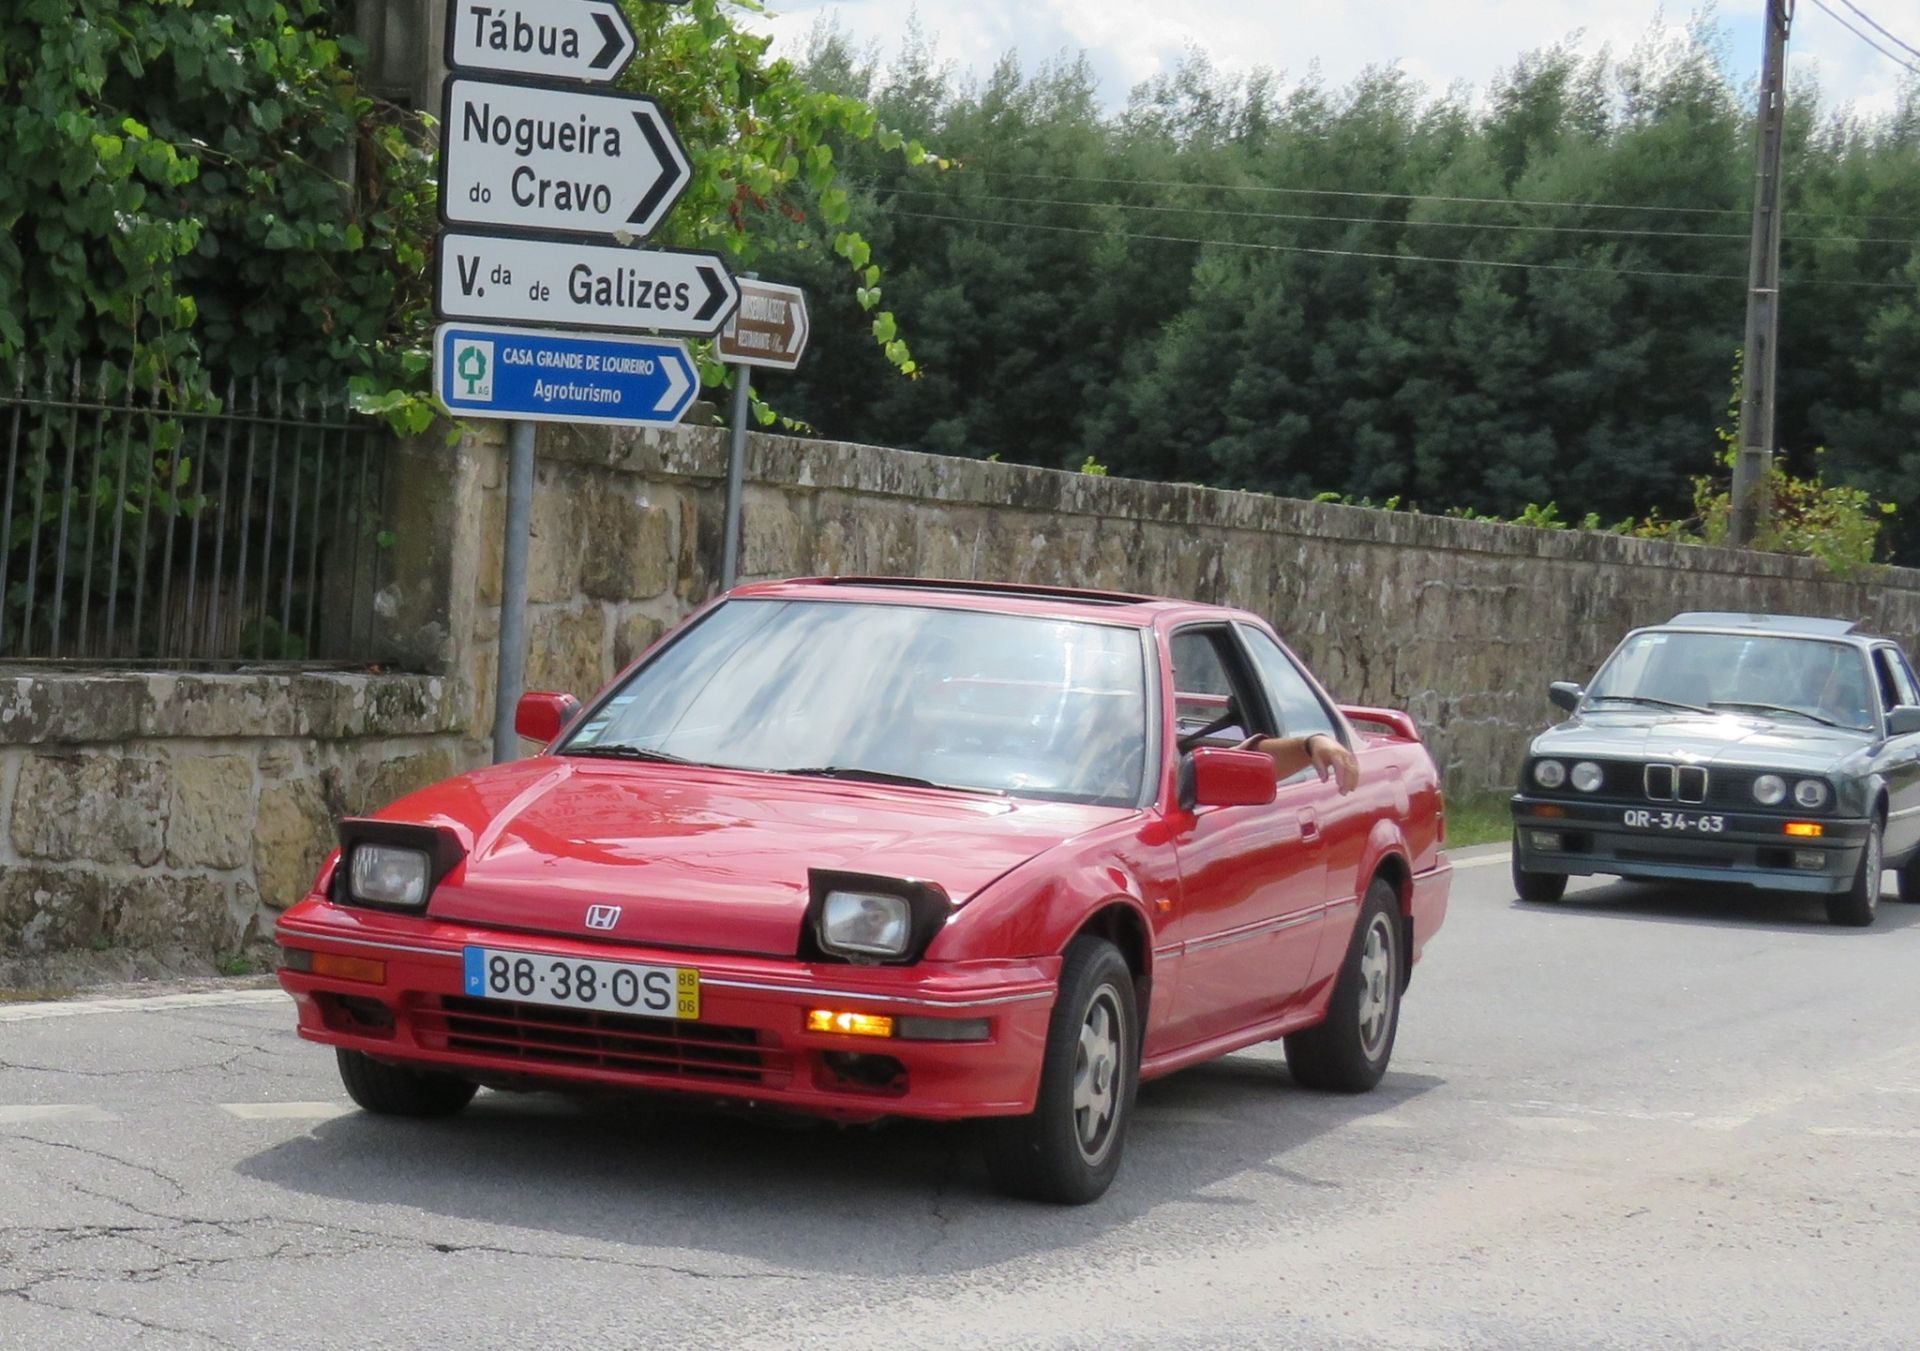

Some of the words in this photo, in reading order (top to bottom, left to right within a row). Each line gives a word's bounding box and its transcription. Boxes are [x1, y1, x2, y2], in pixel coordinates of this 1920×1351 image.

[470, 5, 580, 59] Tábua
[463, 100, 621, 158] Nogueira
[469, 181, 492, 204] do
[511, 165, 612, 215] Cravo
[528, 280, 550, 302] de
[568, 263, 690, 312] Galizes
[502, 347, 534, 366] CASA
[536, 350, 584, 370] GRANDE
[585, 354, 601, 371] DE
[601, 356, 655, 376] LOUREIRO
[477, 385, 490, 396] AG
[533, 378, 622, 404] Agroturismo
[1624, 809, 1724, 833] QR-34-63
[678, 972, 696, 987] 88
[677, 999, 696, 1014] 06
